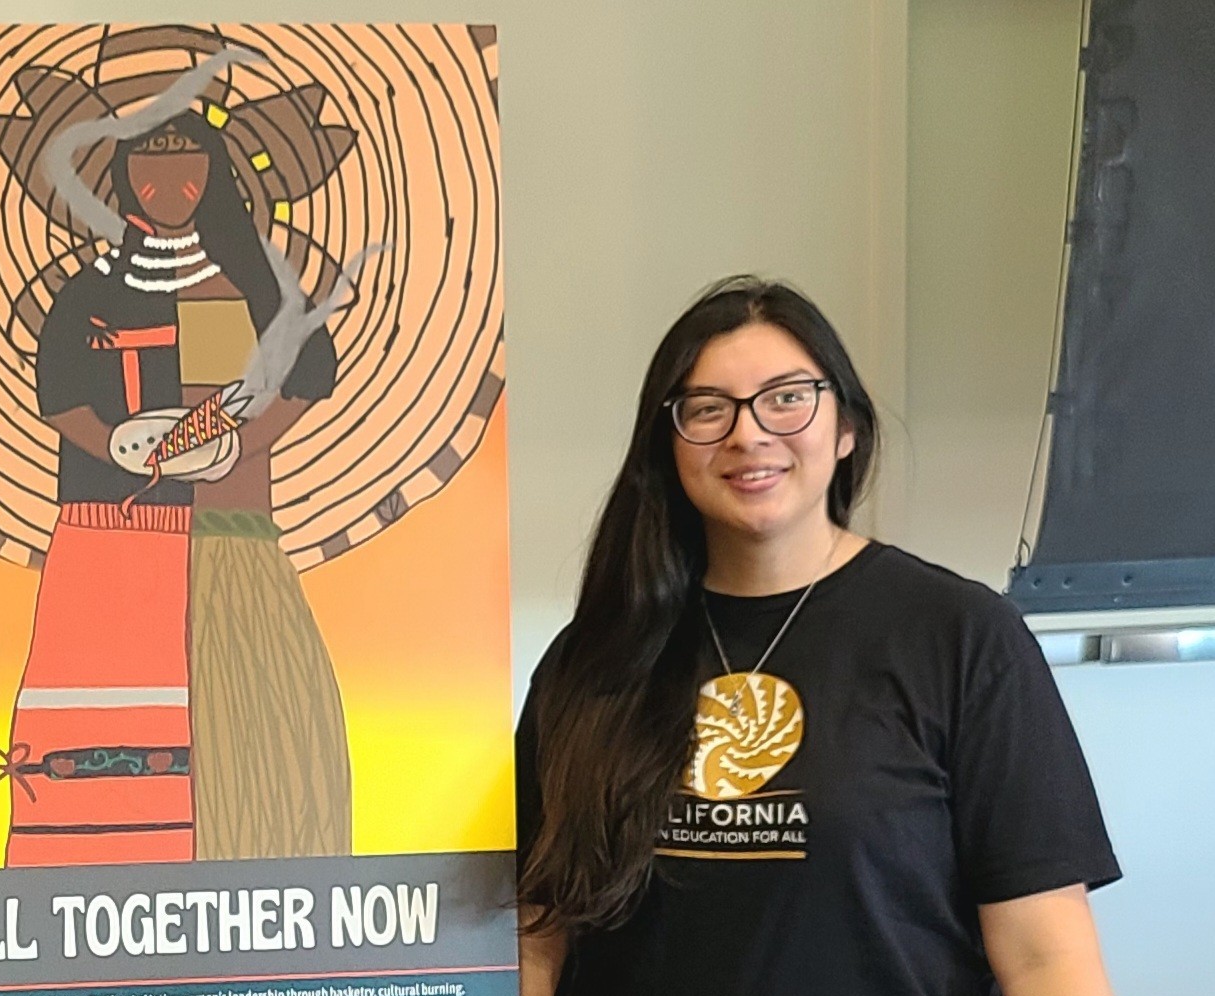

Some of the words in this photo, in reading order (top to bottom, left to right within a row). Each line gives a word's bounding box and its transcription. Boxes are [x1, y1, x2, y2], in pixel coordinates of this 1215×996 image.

[668, 802, 809, 826] LIFORNIA
[672, 829, 749, 844] EDUCATION
[752, 830, 779, 844] FOR
[781, 830, 807, 843] ALL
[52, 887, 316, 958] TOGETHER
[331, 883, 438, 948] NOW
